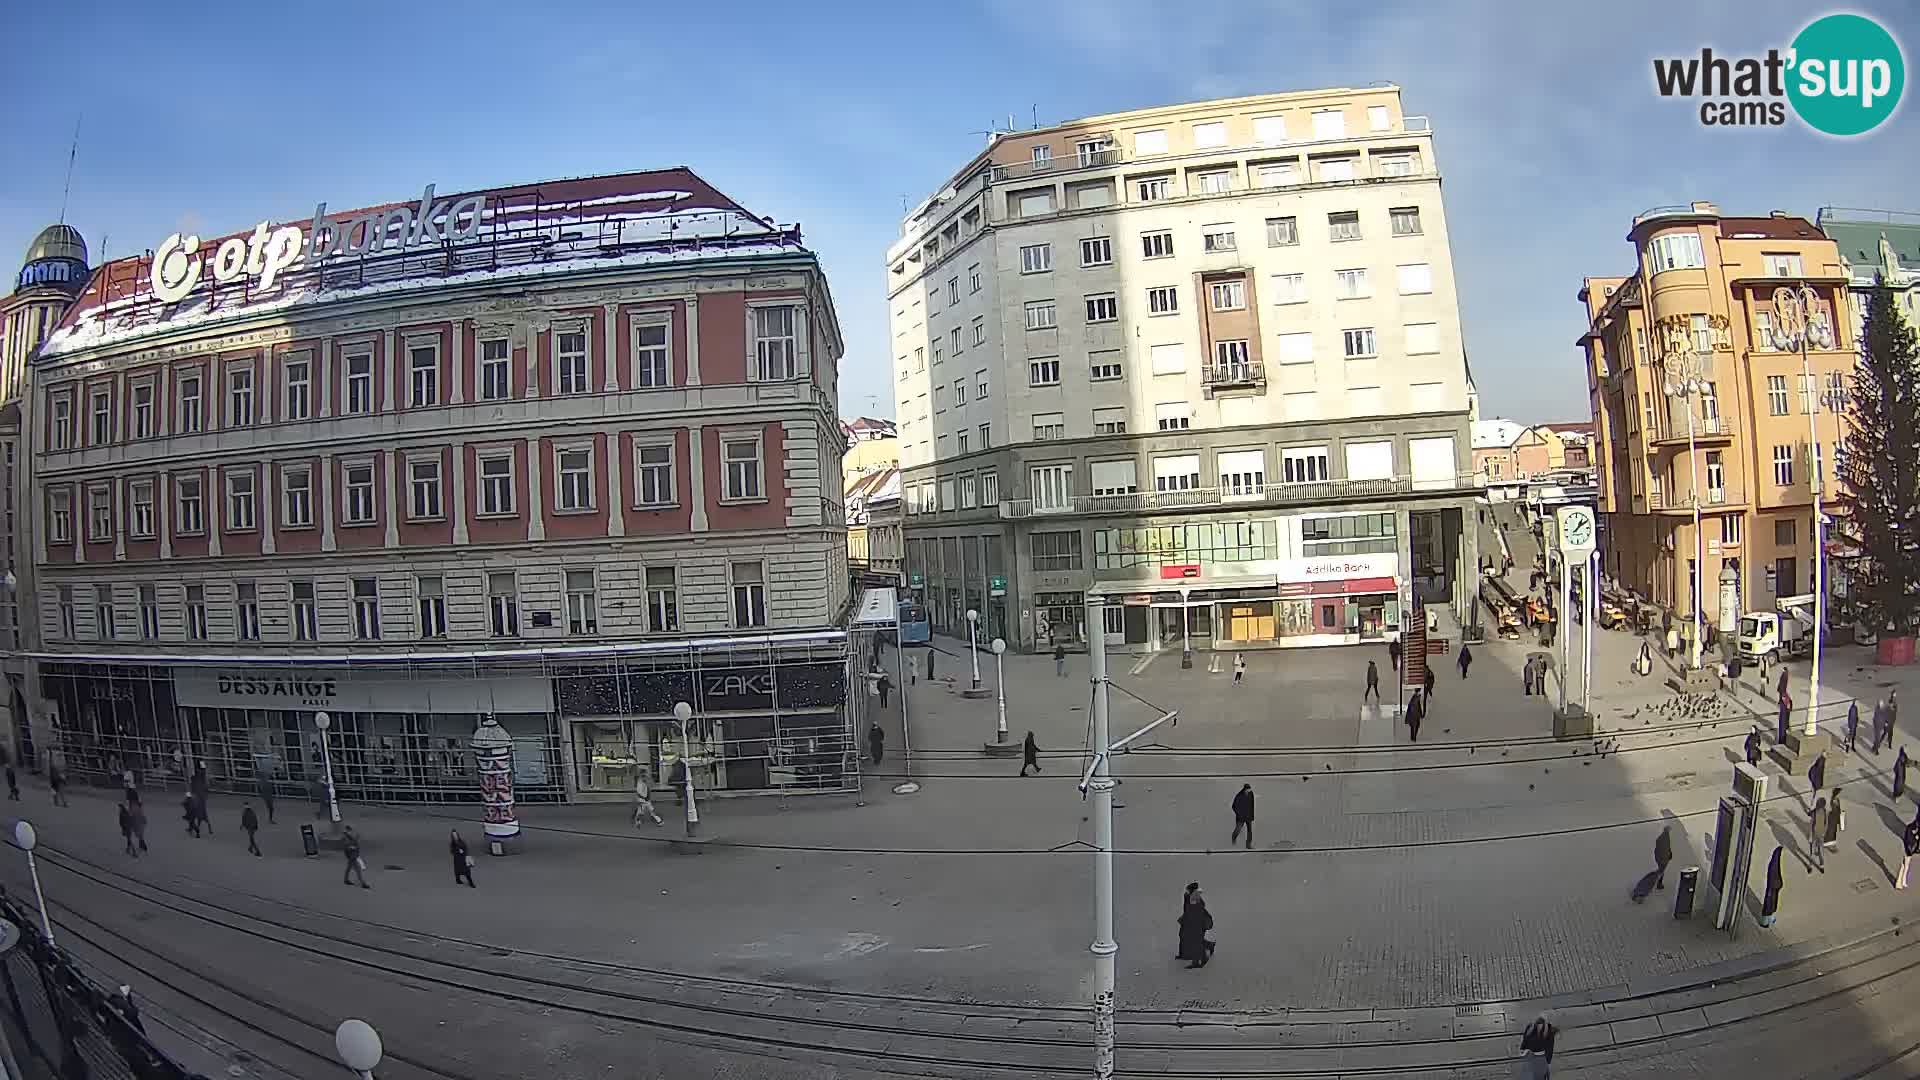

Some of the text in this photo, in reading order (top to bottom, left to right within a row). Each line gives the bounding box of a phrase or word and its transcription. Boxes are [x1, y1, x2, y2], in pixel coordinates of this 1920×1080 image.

[213, 183, 487, 292] otp banka
[218, 676, 337, 697] DESSANGE
[705, 675, 775, 695] ZAKS
